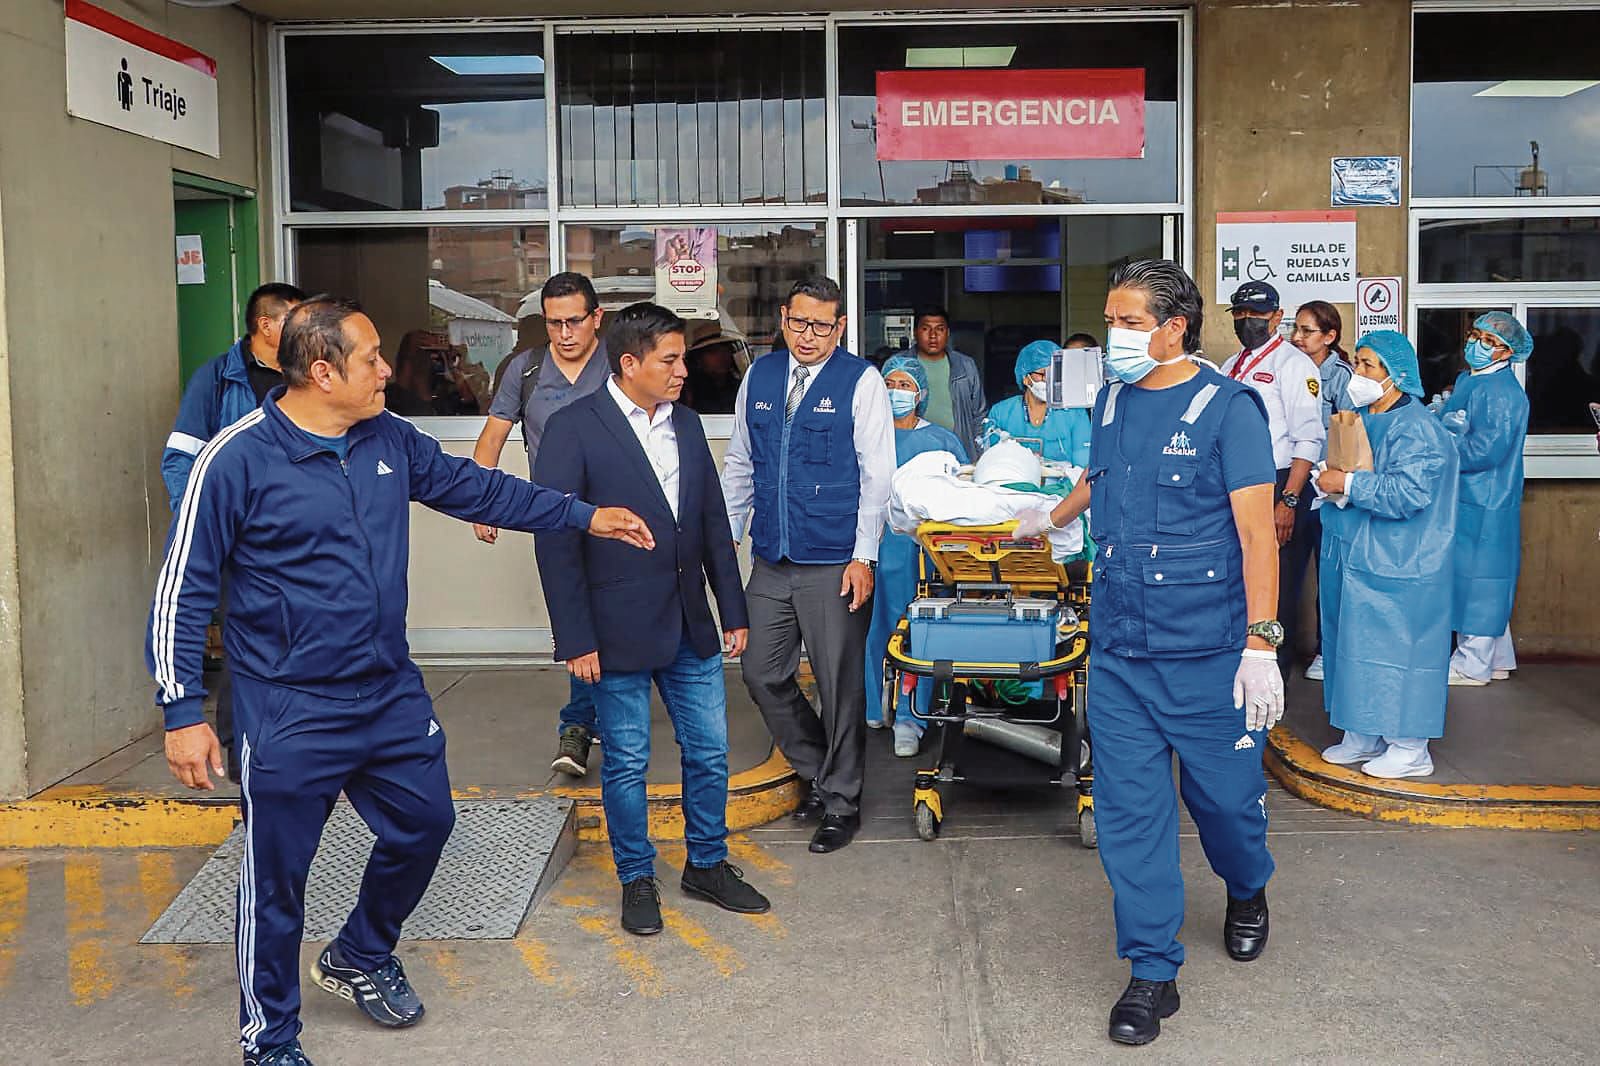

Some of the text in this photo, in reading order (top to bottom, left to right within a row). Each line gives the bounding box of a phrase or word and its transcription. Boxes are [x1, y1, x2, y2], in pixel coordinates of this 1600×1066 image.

[141, 76, 186, 121] Triaje
[901, 99, 1120, 127] EMERGENCIA
[1290, 243, 1347, 253] SILLA DE
[1286, 257, 1350, 268] RUEDAS Y
[672, 265, 701, 273] STOP
[1286, 272, 1350, 282] CAMILLAS
[1360, 314, 1398, 326] LO ESTAMOS
[755, 401, 772, 410] GRAJ
[1162, 446, 1197, 456] EsSalud
